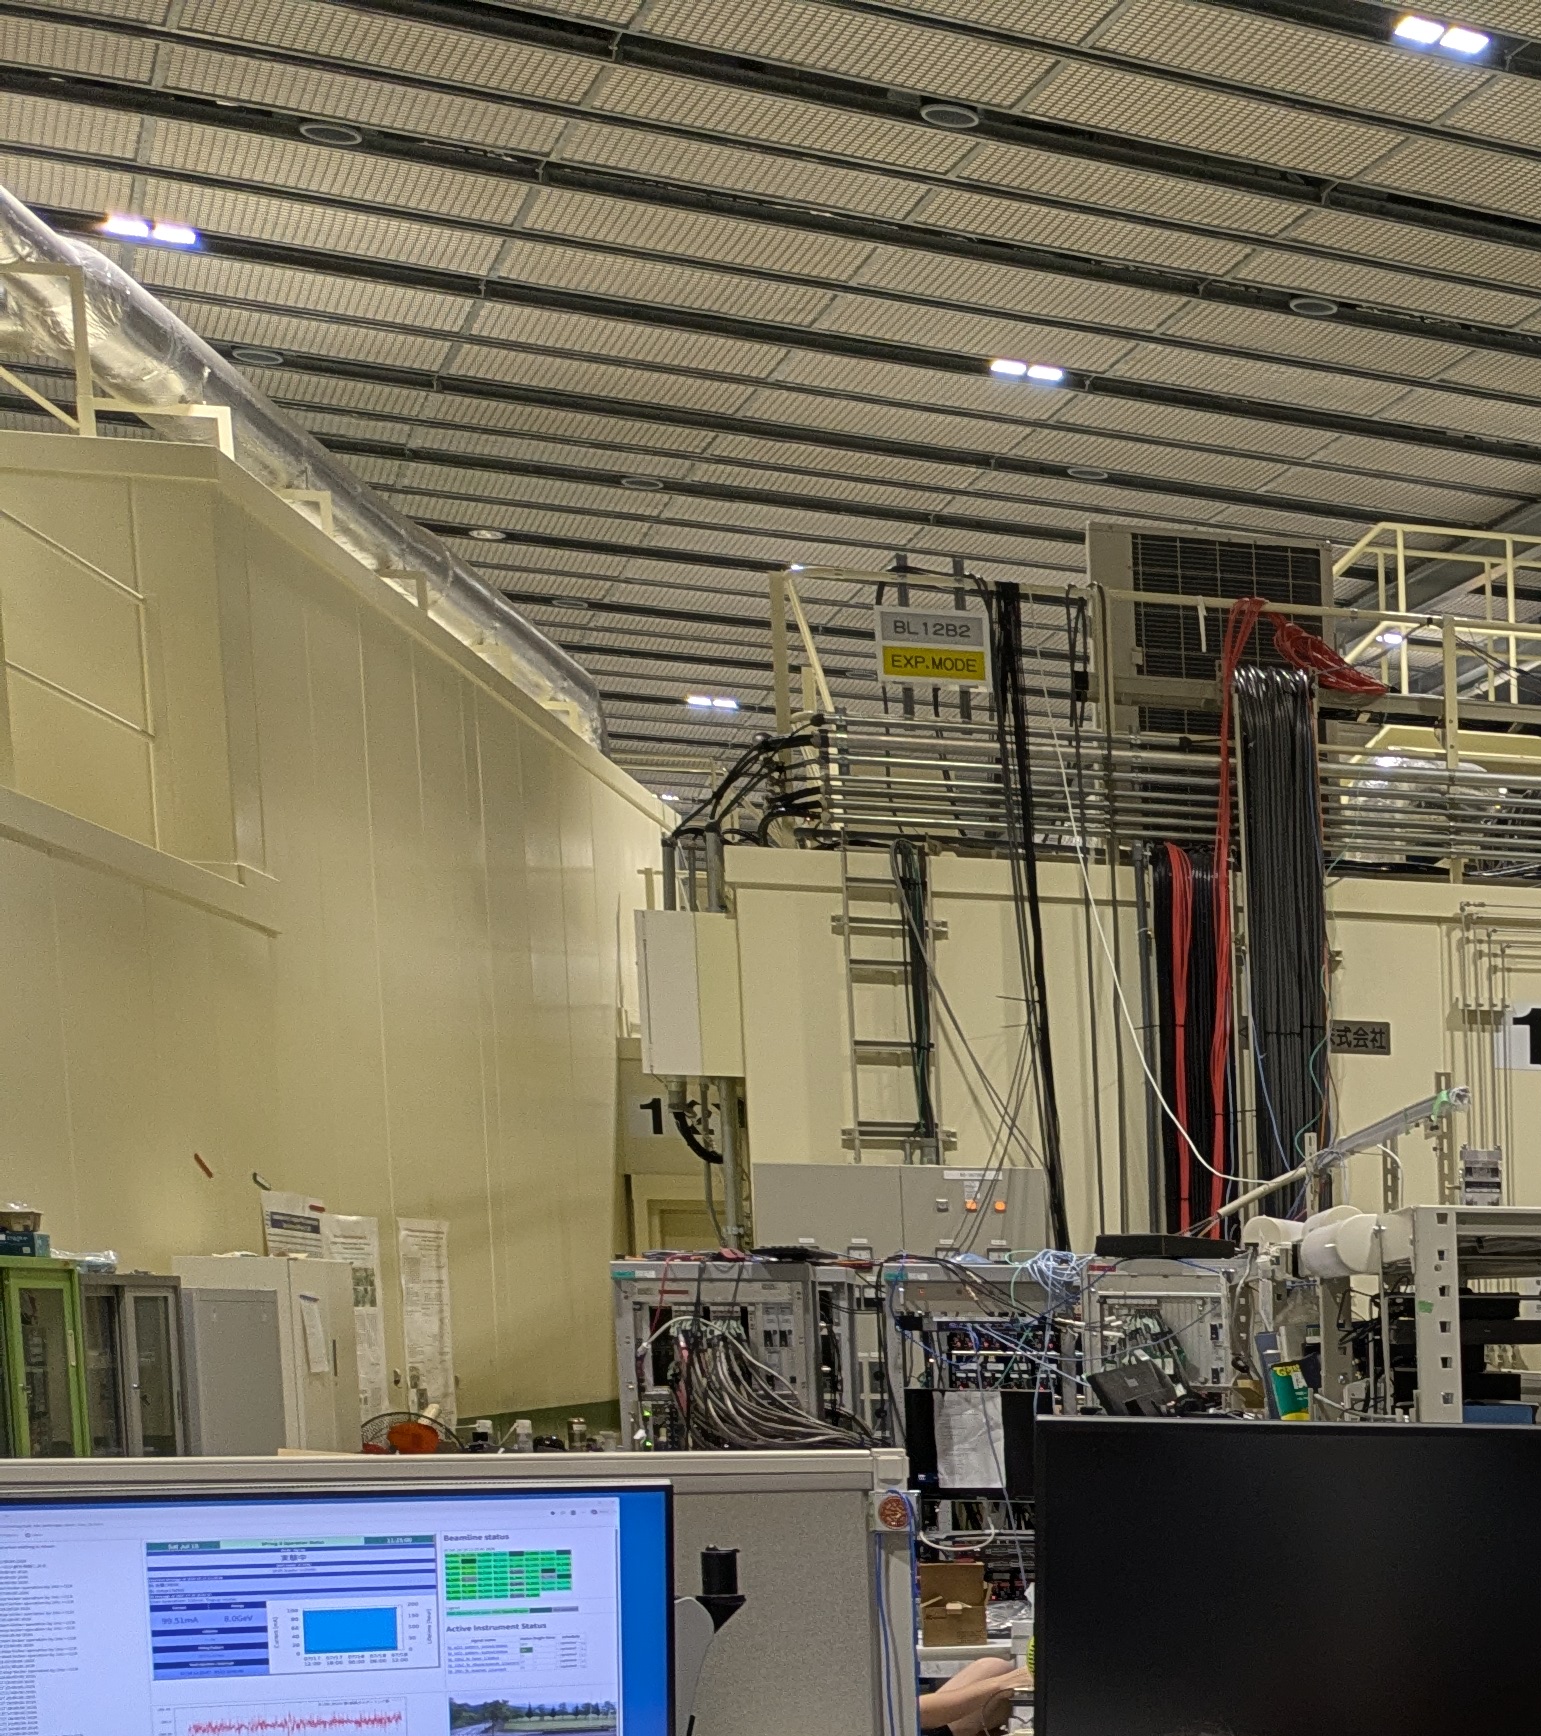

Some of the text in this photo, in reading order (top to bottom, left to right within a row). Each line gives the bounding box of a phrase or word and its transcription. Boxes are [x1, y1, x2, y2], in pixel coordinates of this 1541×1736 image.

[893, 620, 971, 638] BL12B2
[891, 654, 977, 673] EXP.MODE
[444, 1533, 510, 1542] Beamline status
